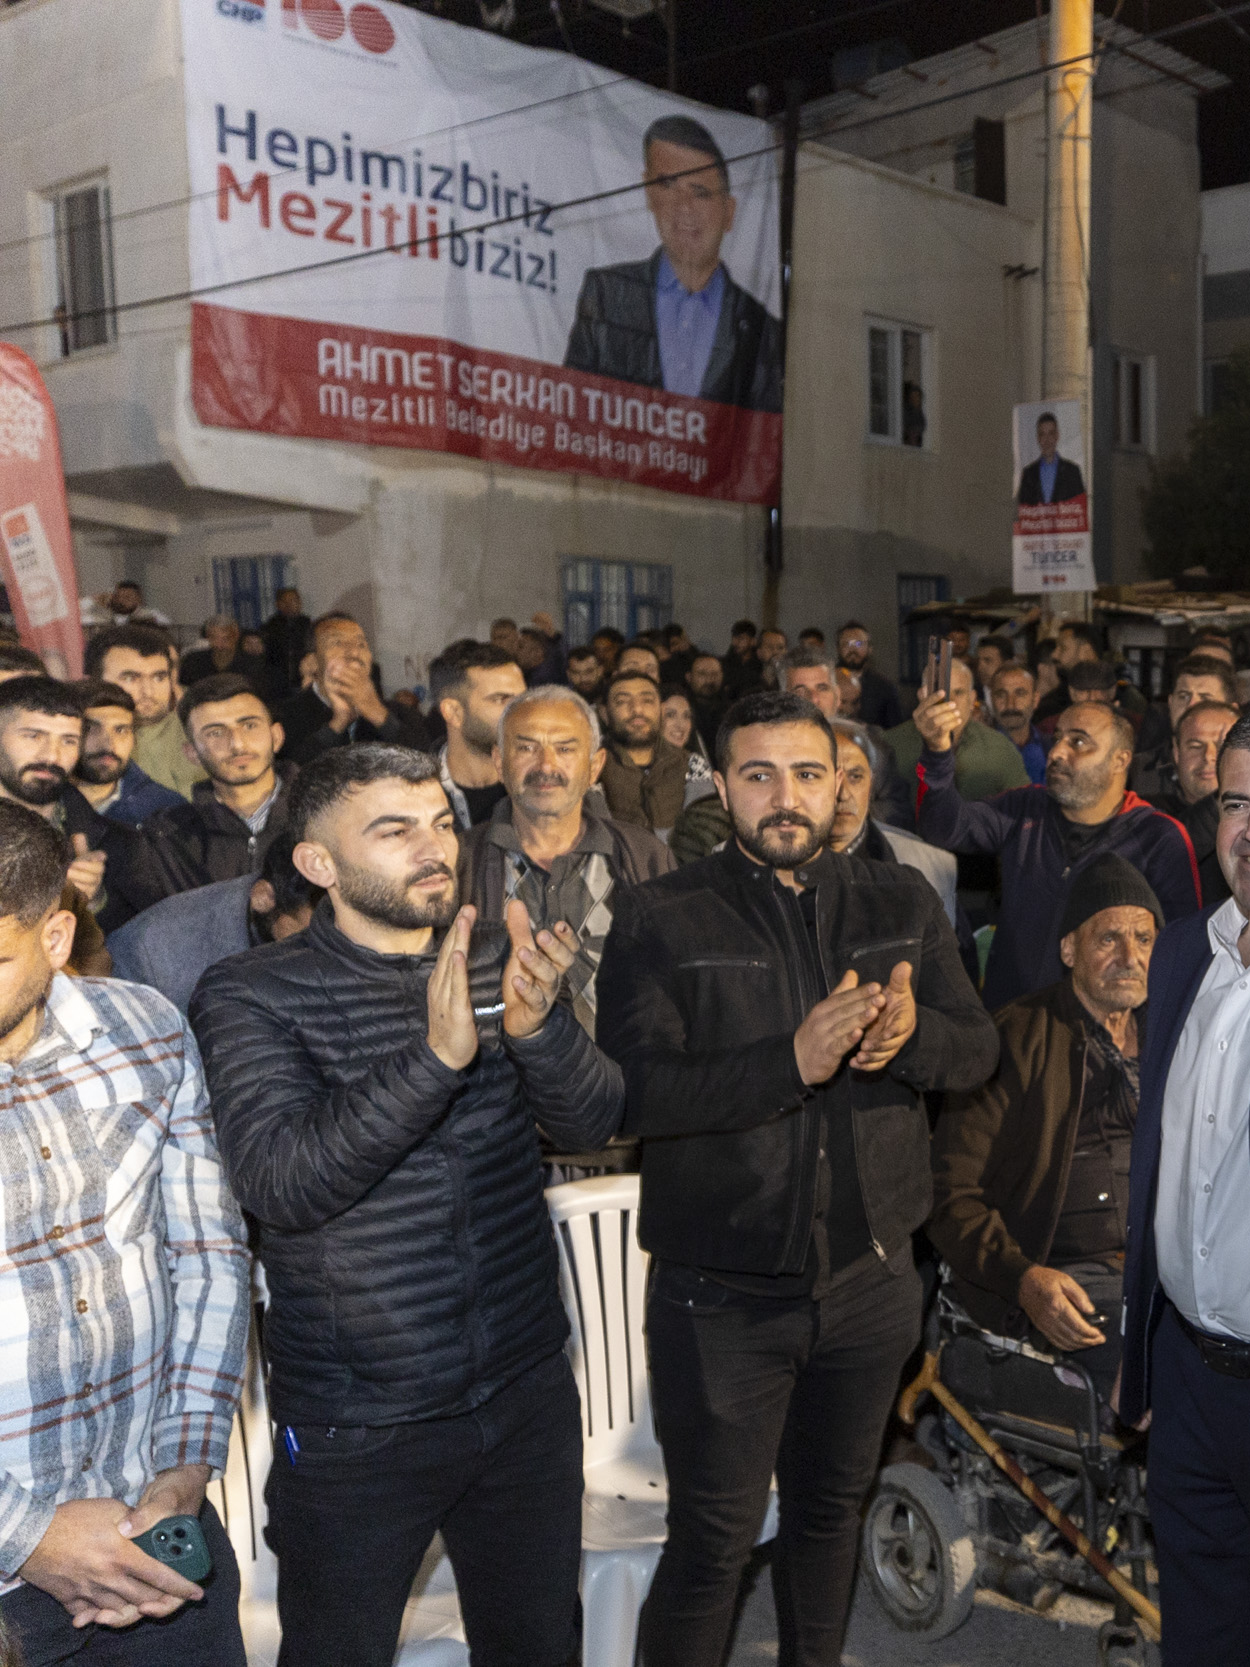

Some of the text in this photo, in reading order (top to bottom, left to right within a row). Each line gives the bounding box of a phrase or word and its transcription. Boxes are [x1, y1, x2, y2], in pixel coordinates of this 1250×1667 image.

[216, 162, 558, 293] Mezitli biziz!
[317, 337, 707, 445] AHMET SERKAN TUNCER
[318, 383, 709, 484] Mezitli Belediye Başkan Adayı
